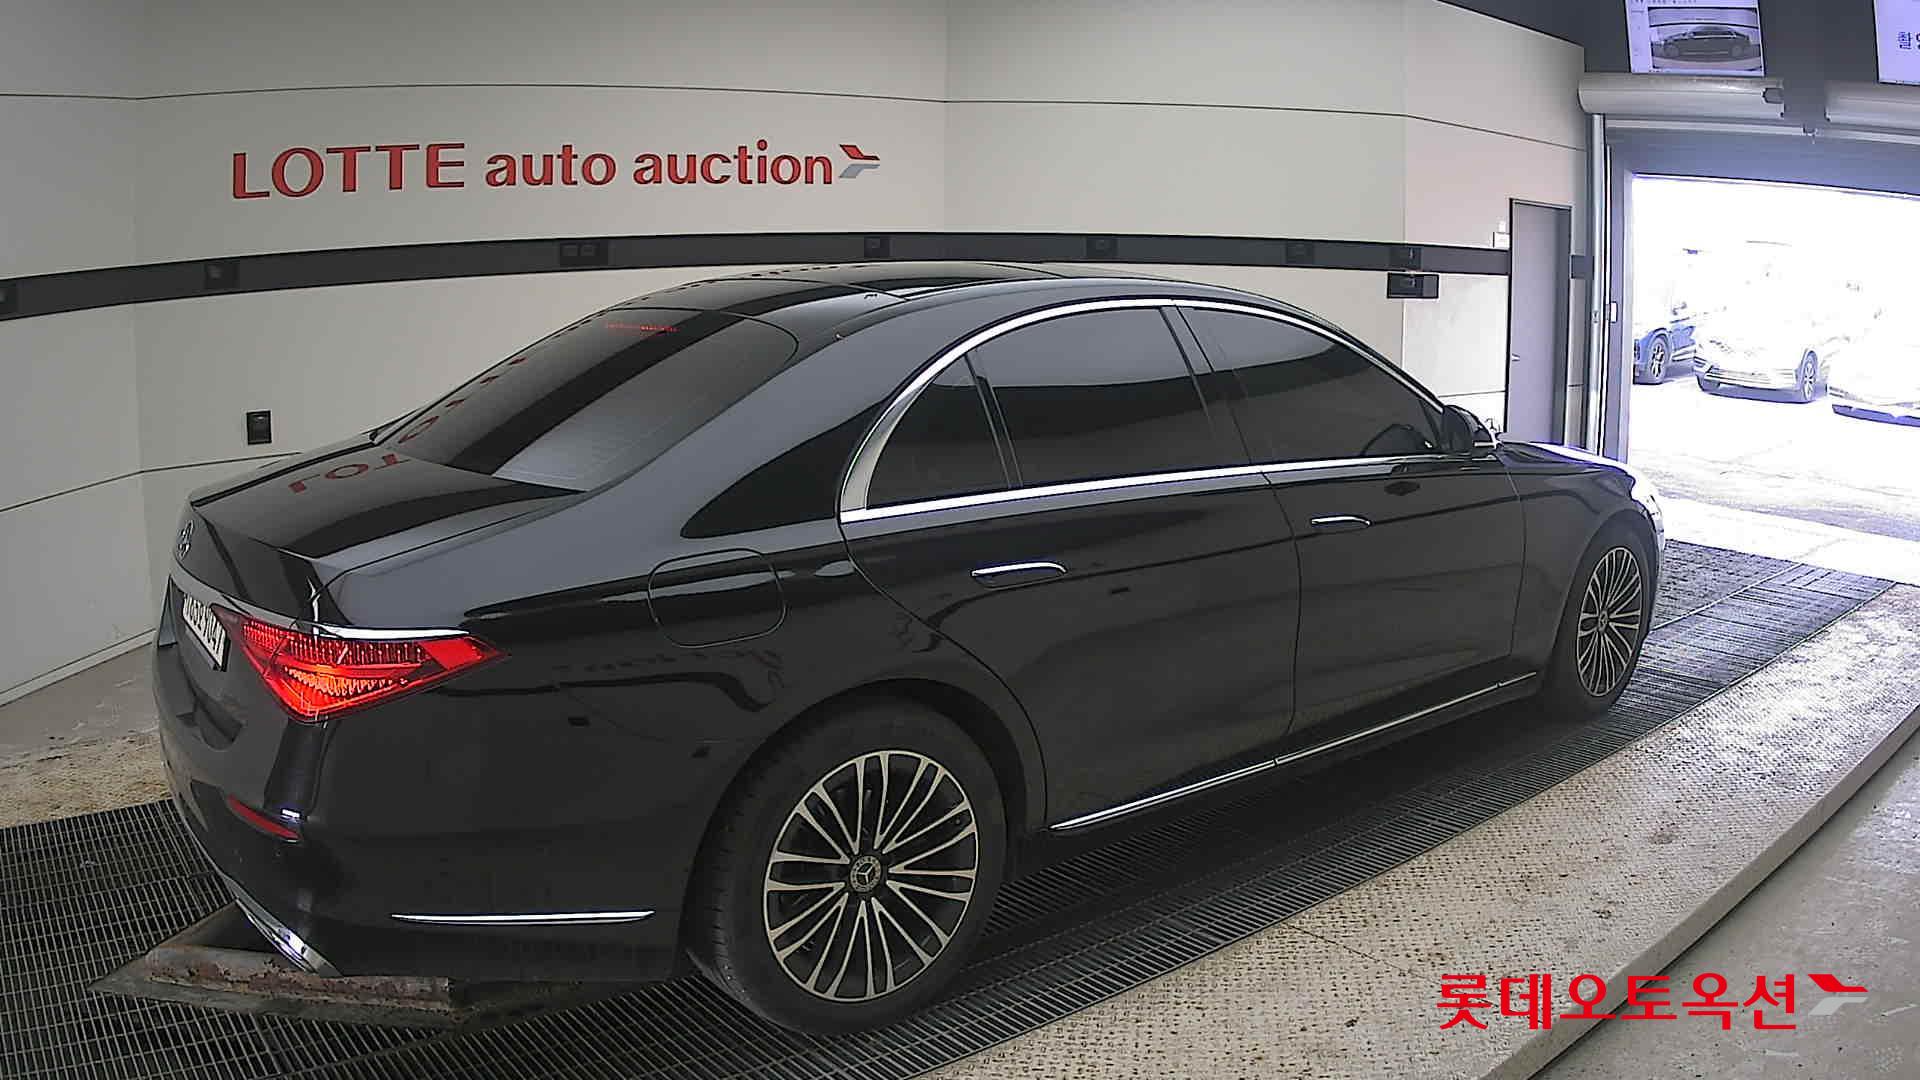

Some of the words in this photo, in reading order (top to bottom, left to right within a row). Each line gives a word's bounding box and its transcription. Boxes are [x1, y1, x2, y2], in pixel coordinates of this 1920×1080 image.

[232, 142, 466, 200] LOTTE
[484, 143, 617, 187] auto
[633, 138, 833, 186] auction
